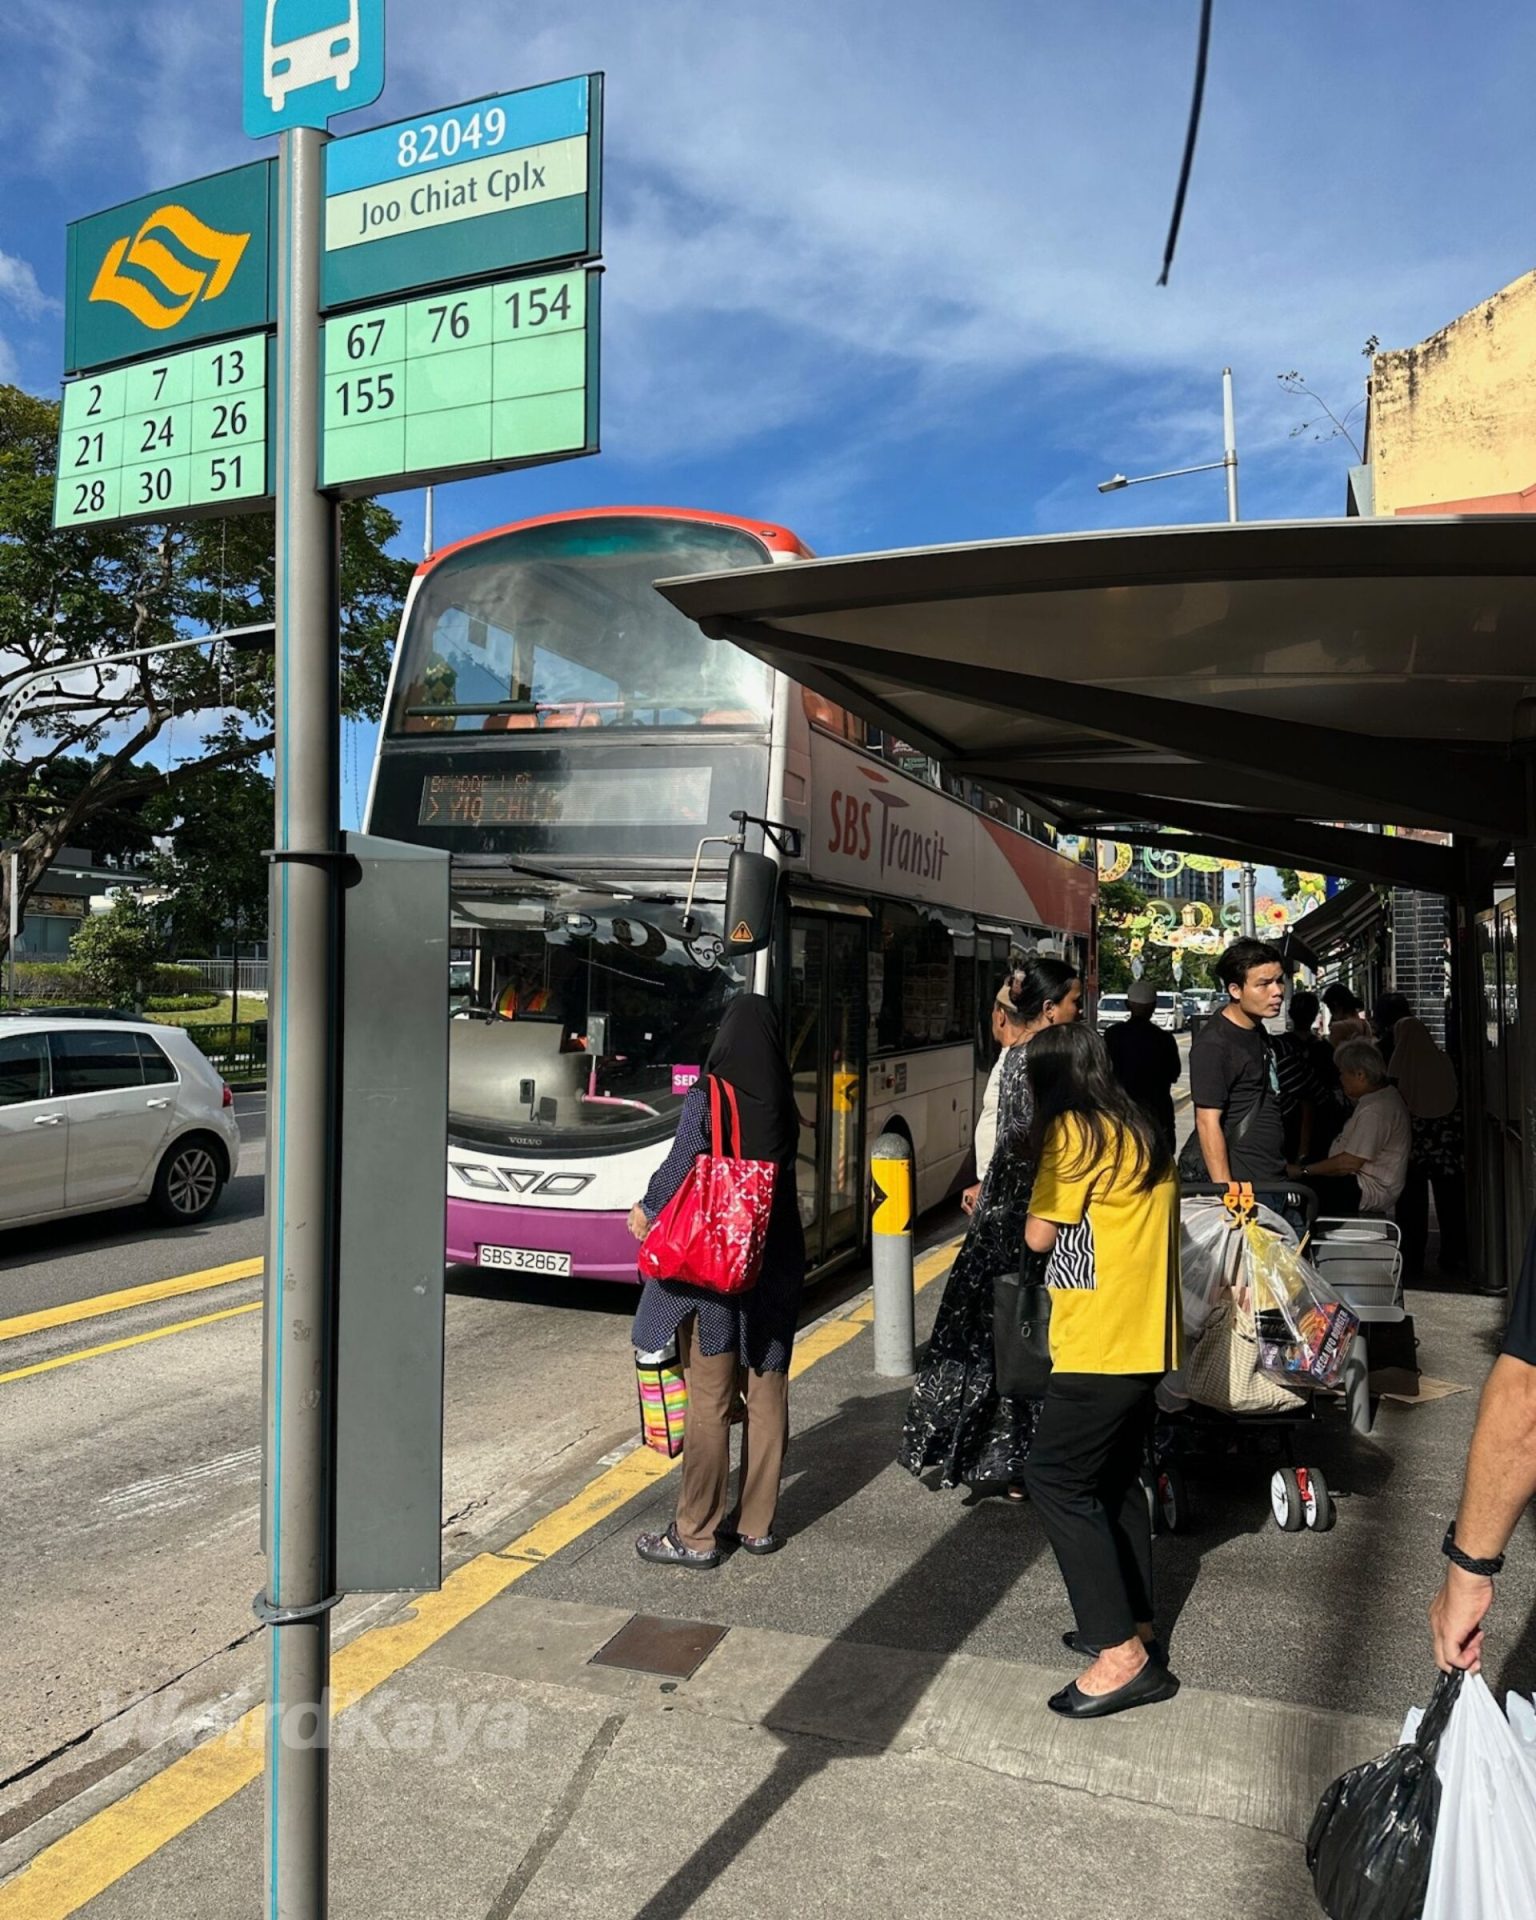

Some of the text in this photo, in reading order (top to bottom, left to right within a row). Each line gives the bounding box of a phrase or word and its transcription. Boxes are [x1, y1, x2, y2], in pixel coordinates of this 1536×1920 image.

[398, 107, 508, 168] 82049
[361, 161, 546, 234] Joo Chiat Cplx
[347, 284, 571, 359] 67 76 154
[86, 351, 244, 416] 2 7 13
[337, 373, 394, 416] 155
[75, 401, 246, 467] 21 24 26
[73, 456, 241, 515] 28 30 51
[828, 788, 950, 881] SBS Transit
[508, 1136, 543, 1146] VOLVO
[482, 1247, 569, 1273] SBS3286Z
[1314, 1351, 1330, 1375] MEGA
